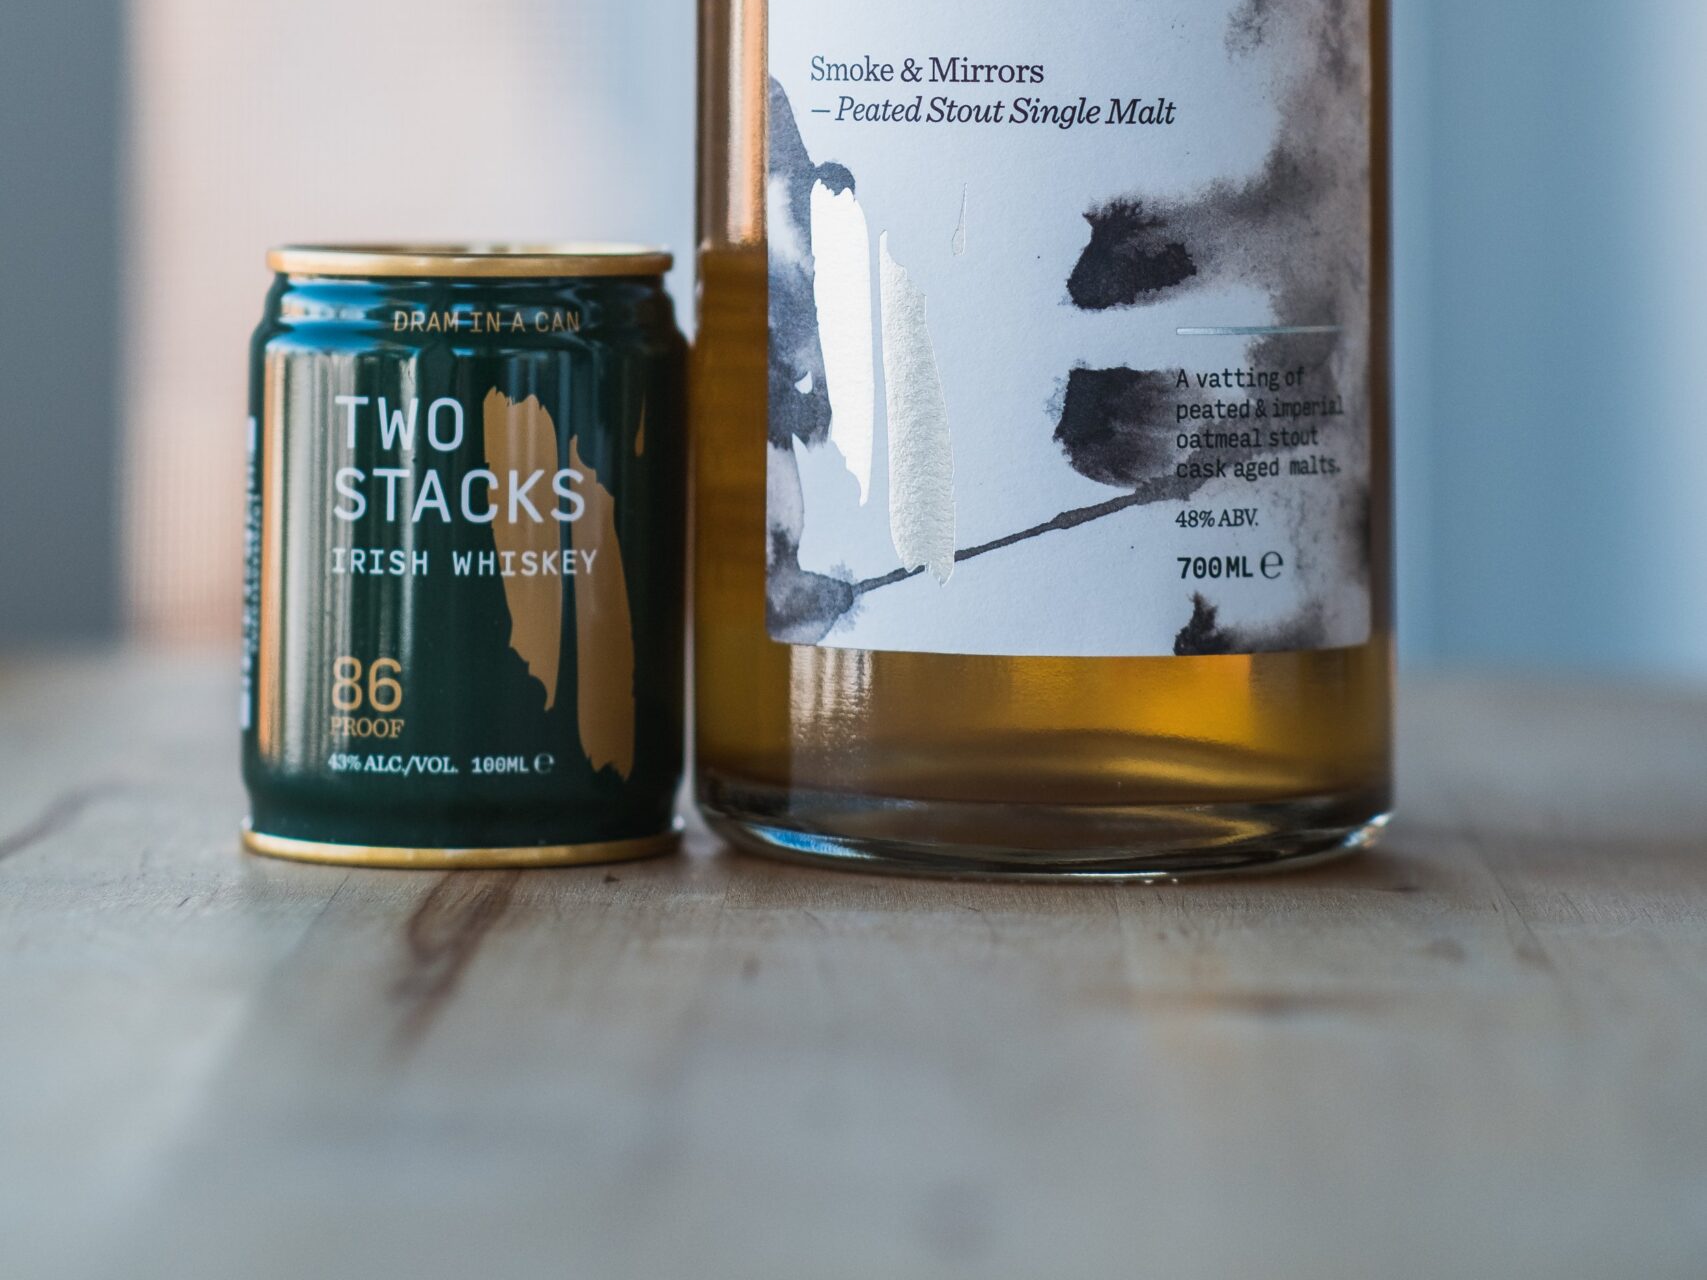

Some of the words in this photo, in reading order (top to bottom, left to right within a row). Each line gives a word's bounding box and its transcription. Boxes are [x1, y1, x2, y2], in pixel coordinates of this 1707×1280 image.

[810, 55, 894, 82] Smoke
[900, 58, 923, 82] &
[928, 57, 1045, 83] Mirrors
[835, 96, 923, 122] Peated
[926, 97, 1006, 123] Stout
[1008, 97, 1102, 130] Single
[1105, 98, 1177, 125] Malt
[394, 310, 459, 332] DRAM
[469, 311, 500, 333] IN
[511, 311, 526, 333] A
[535, 311, 580, 333] CAN
[1176, 369, 1190, 388] A
[1196, 367, 1280, 391] vatting
[1286, 366, 1304, 387] of
[1176, 399, 1250, 423] peated
[1255, 401, 1268, 419] &
[1272, 395, 1344, 419] imperial
[334, 396, 465, 452] TWO
[1176, 428, 1262, 449] oatmeal
[1268, 425, 1319, 448] stout
[1176, 458, 1226, 479] cask
[1234, 457, 1280, 481] aged
[1289, 455, 1341, 477] malts.
[333, 468, 587, 524] STACKS
[1174, 510, 1216, 529] 48%
[1217, 507, 1259, 528] ABV.
[331, 548, 428, 577] IRISH
[452, 549, 597, 577] WHISKEY
[331, 656, 403, 713] 86
[330, 717, 405, 739] PROOF
[328, 753, 362, 771] 43%
[471, 757, 530, 774] 100ML
